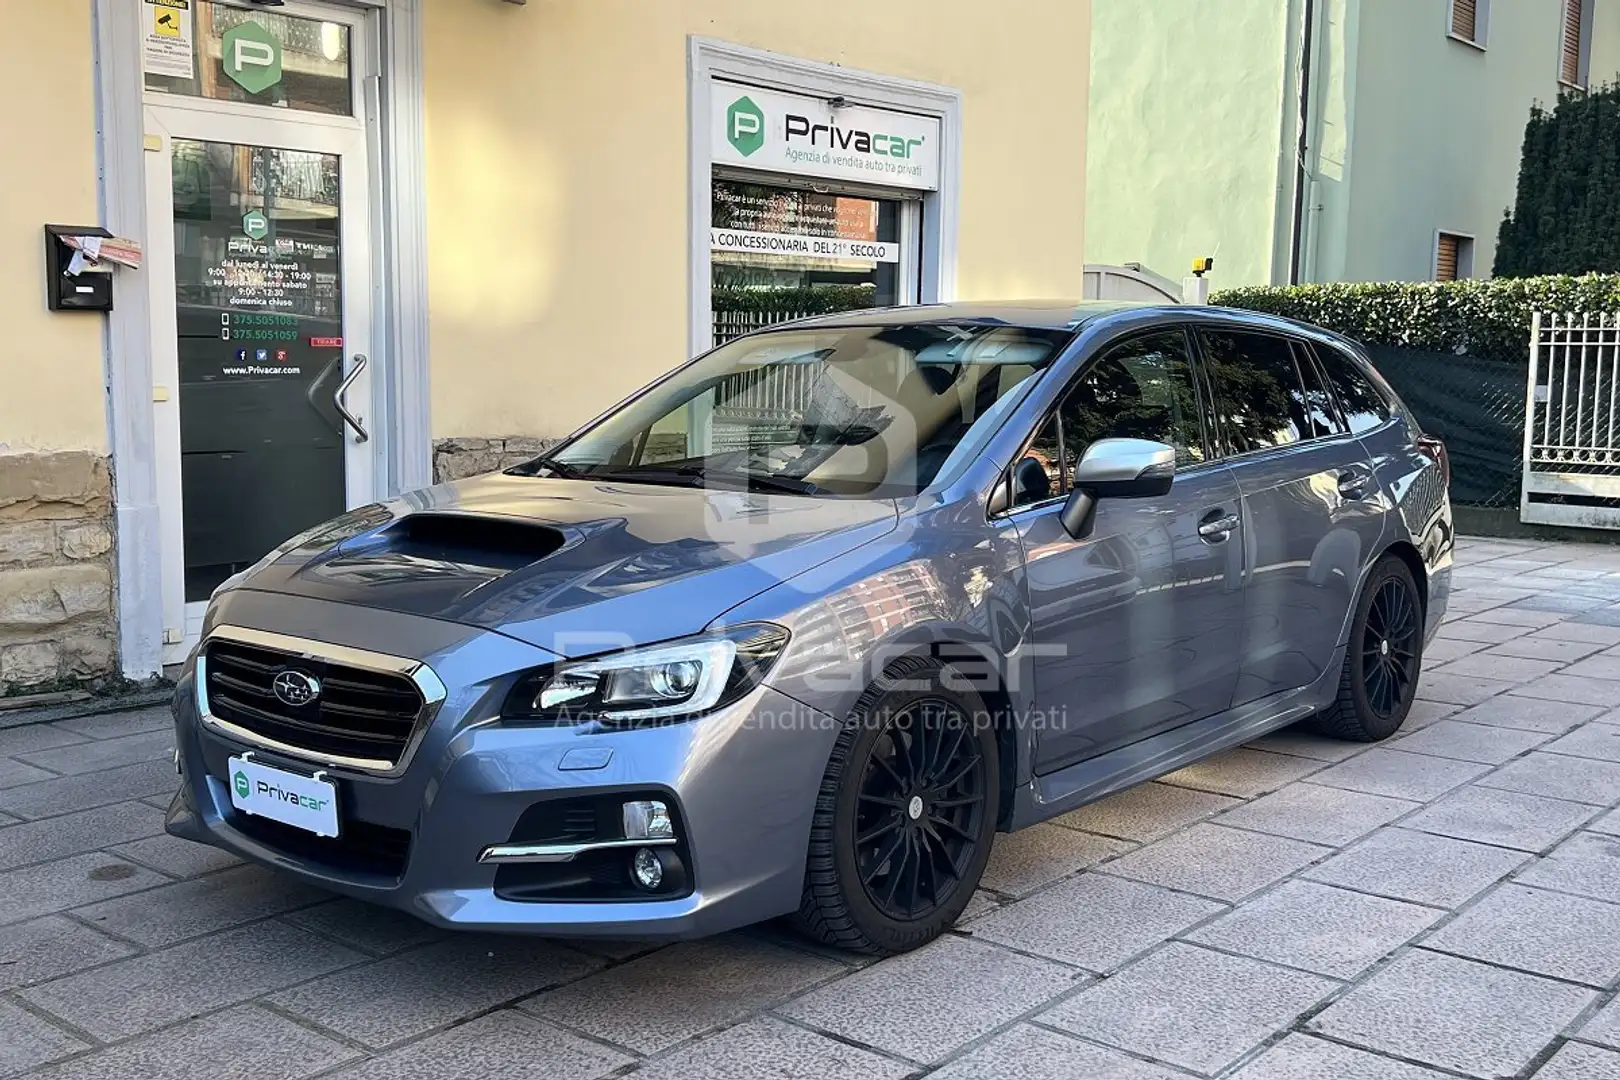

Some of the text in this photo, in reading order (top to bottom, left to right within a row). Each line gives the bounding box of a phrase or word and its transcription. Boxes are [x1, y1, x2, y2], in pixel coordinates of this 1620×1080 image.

[235, 39, 274, 71] P
[734, 111, 923, 159] P Privacar
[785, 147, 922, 176] Agenzia di vendita auto tra privati
[248, 218, 265, 232] P
[718, 232, 809, 252] CONCESSIONARIA
[813, 241, 831, 254] DEL
[850, 244, 885, 258] SECOLO
[221, 259, 234, 267] dal
[208, 268, 226, 276] 9:00
[290, 271, 311, 280] 19:00
[282, 280, 308, 289] sabato
[238, 287, 256, 296] 9:00
[229, 296, 293, 306] domenica chiuso
[233, 329, 298, 340] 375.5051059
[222, 365, 301, 375] www.Privacar.com
[257, 780, 328, 811] Privacar
